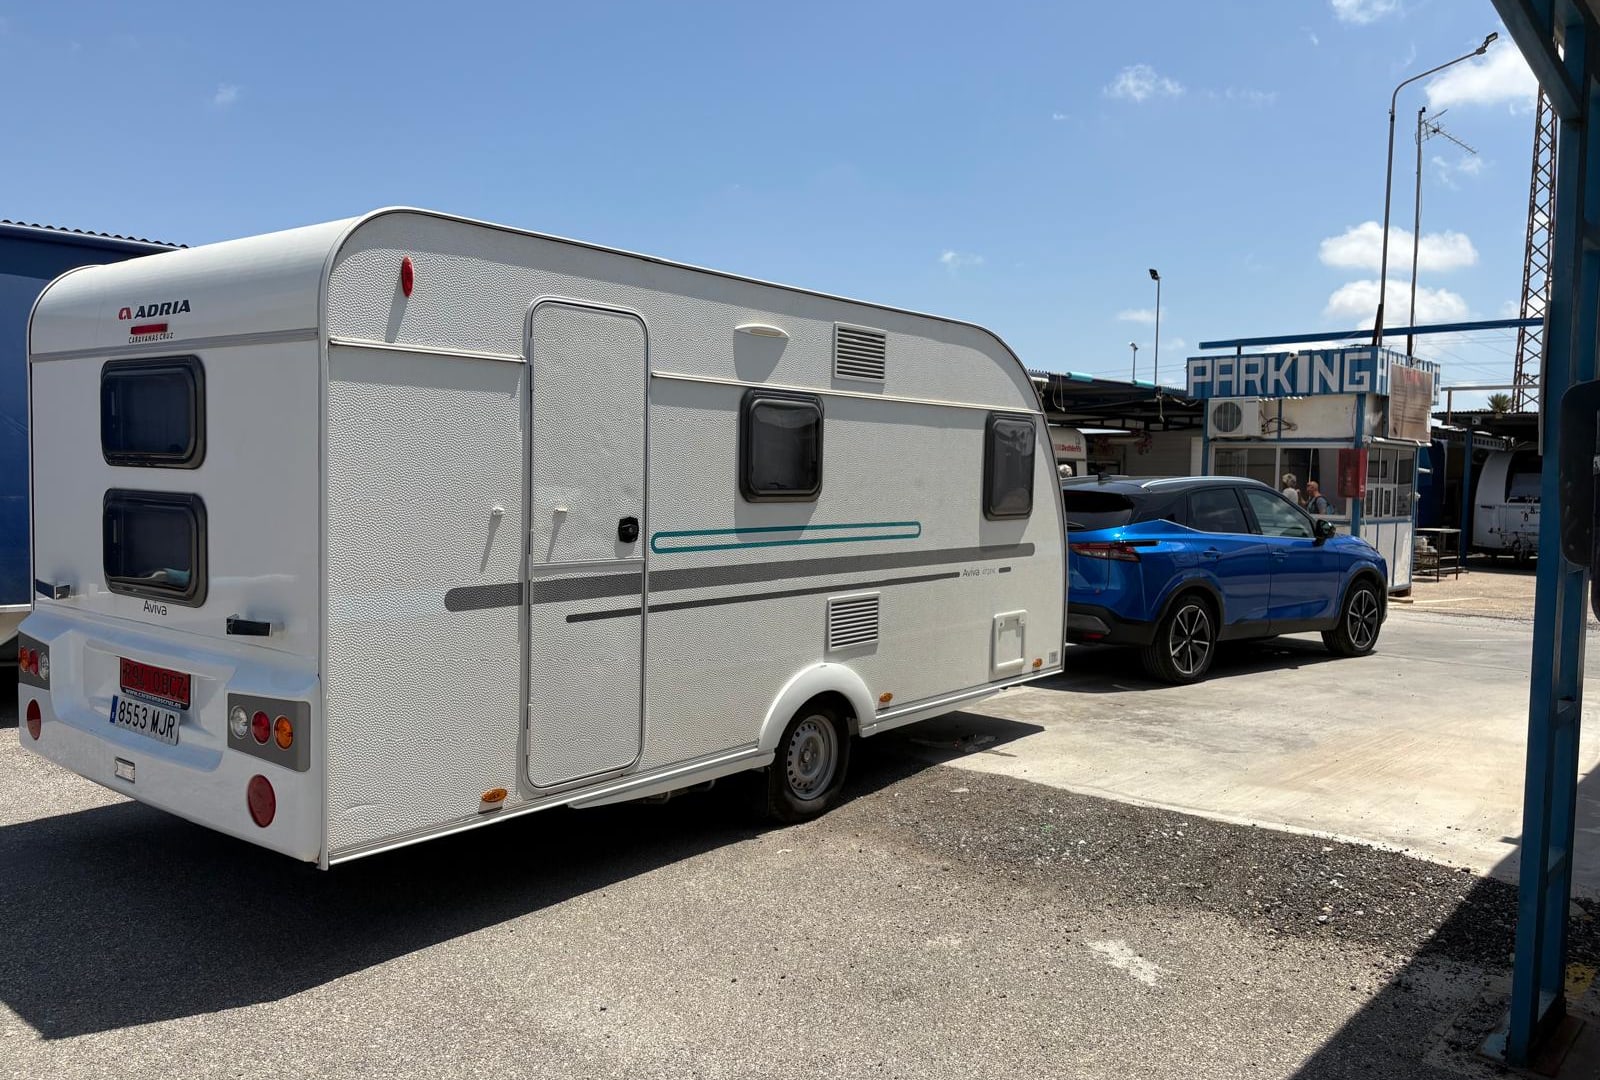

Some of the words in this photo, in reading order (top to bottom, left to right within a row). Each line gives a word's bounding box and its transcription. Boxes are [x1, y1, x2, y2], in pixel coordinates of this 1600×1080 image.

[135, 300, 190, 318] ADRIA
[128, 334, 159, 344] CARAVANAS
[159, 332, 174, 340] CRUZ
[1188, 351, 1371, 397] PARKING
[143, 600, 168, 616] Aviva
[118, 700, 148, 729] 8553
[150, 709, 176, 739] MJR
